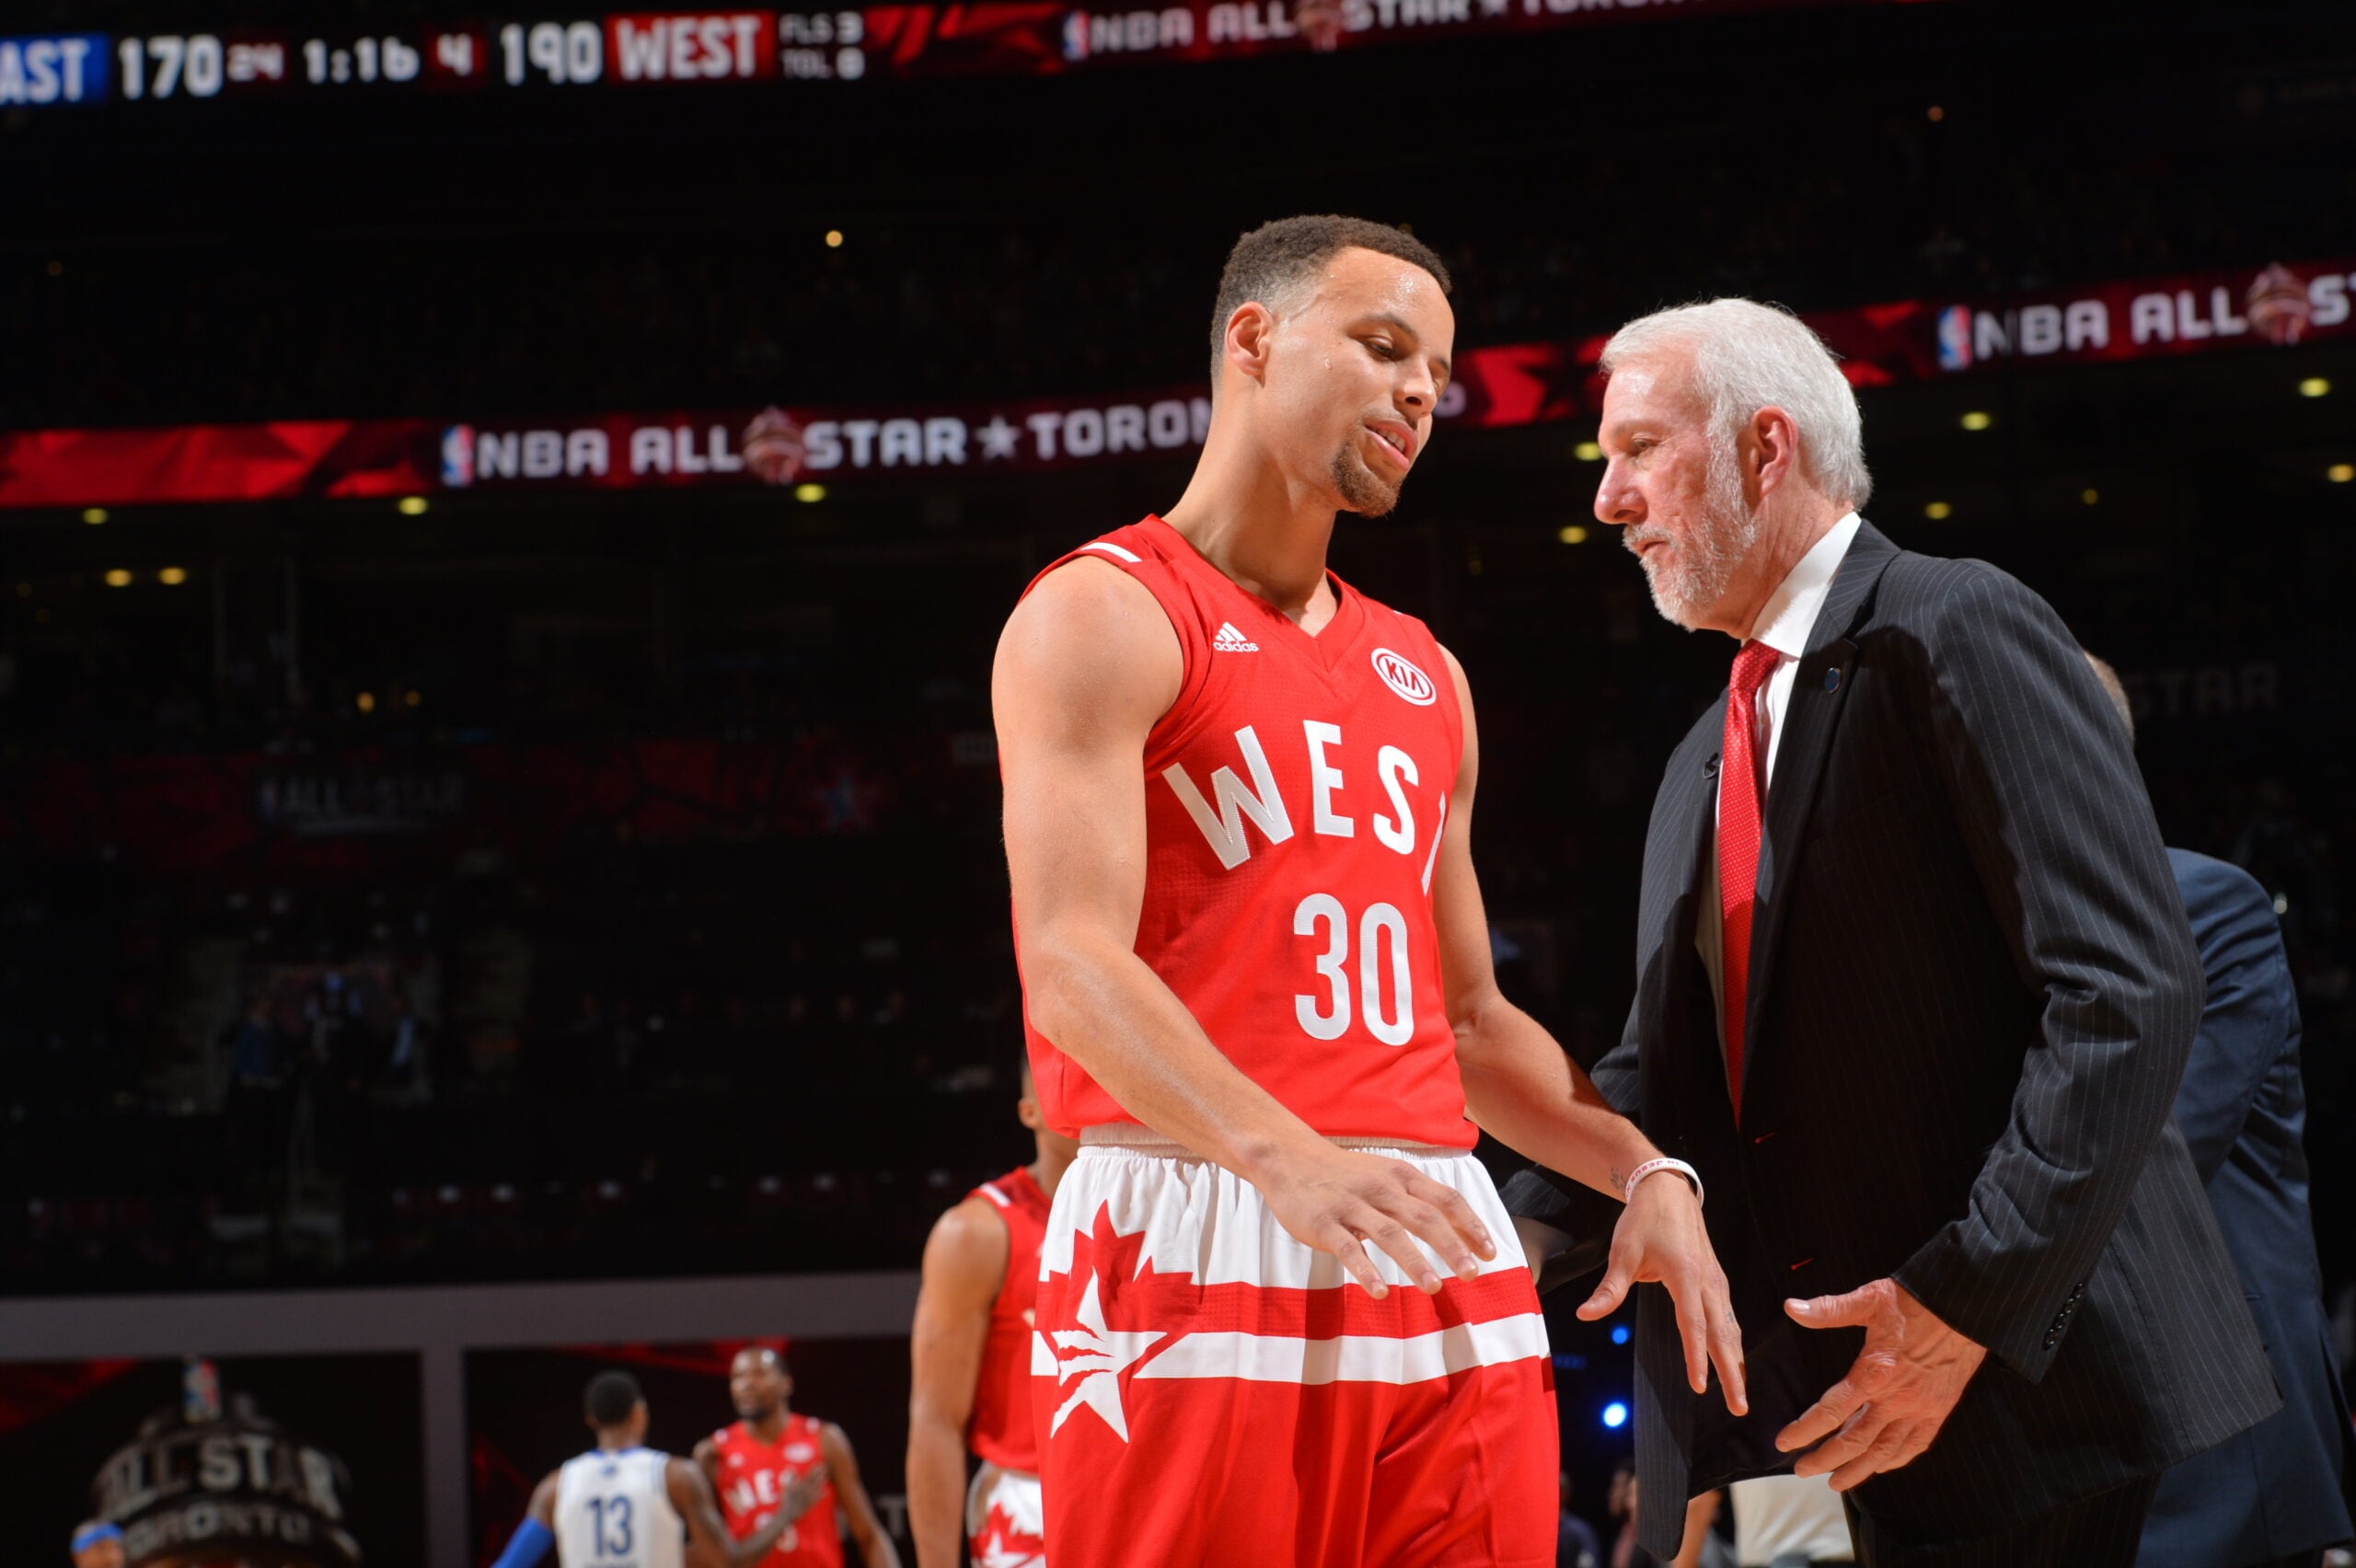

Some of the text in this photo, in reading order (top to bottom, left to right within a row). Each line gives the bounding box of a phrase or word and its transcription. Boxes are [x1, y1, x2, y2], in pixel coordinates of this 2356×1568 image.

[119, 34, 223, 99] 170
[304, 36, 420, 85] 1:16
[436, 33, 472, 76] 4
[501, 21, 603, 86] 190
[616, 15, 762, 81] WEST
[1090, 7, 1195, 53] NBA
[1206, 0, 1298, 44] ALL
[1973, 301, 2109, 360] NBA
[2131, 287, 2247, 344] ALL
[476, 429, 609, 478] NBA
[630, 424, 744, 475] ALL
[802, 417, 967, 469] STAR
[1213, 640, 1259, 652] adidas
[1384, 657, 1426, 696] KIA
[1293, 893, 1415, 1047] 30
[588, 1494, 632, 1558] 13
